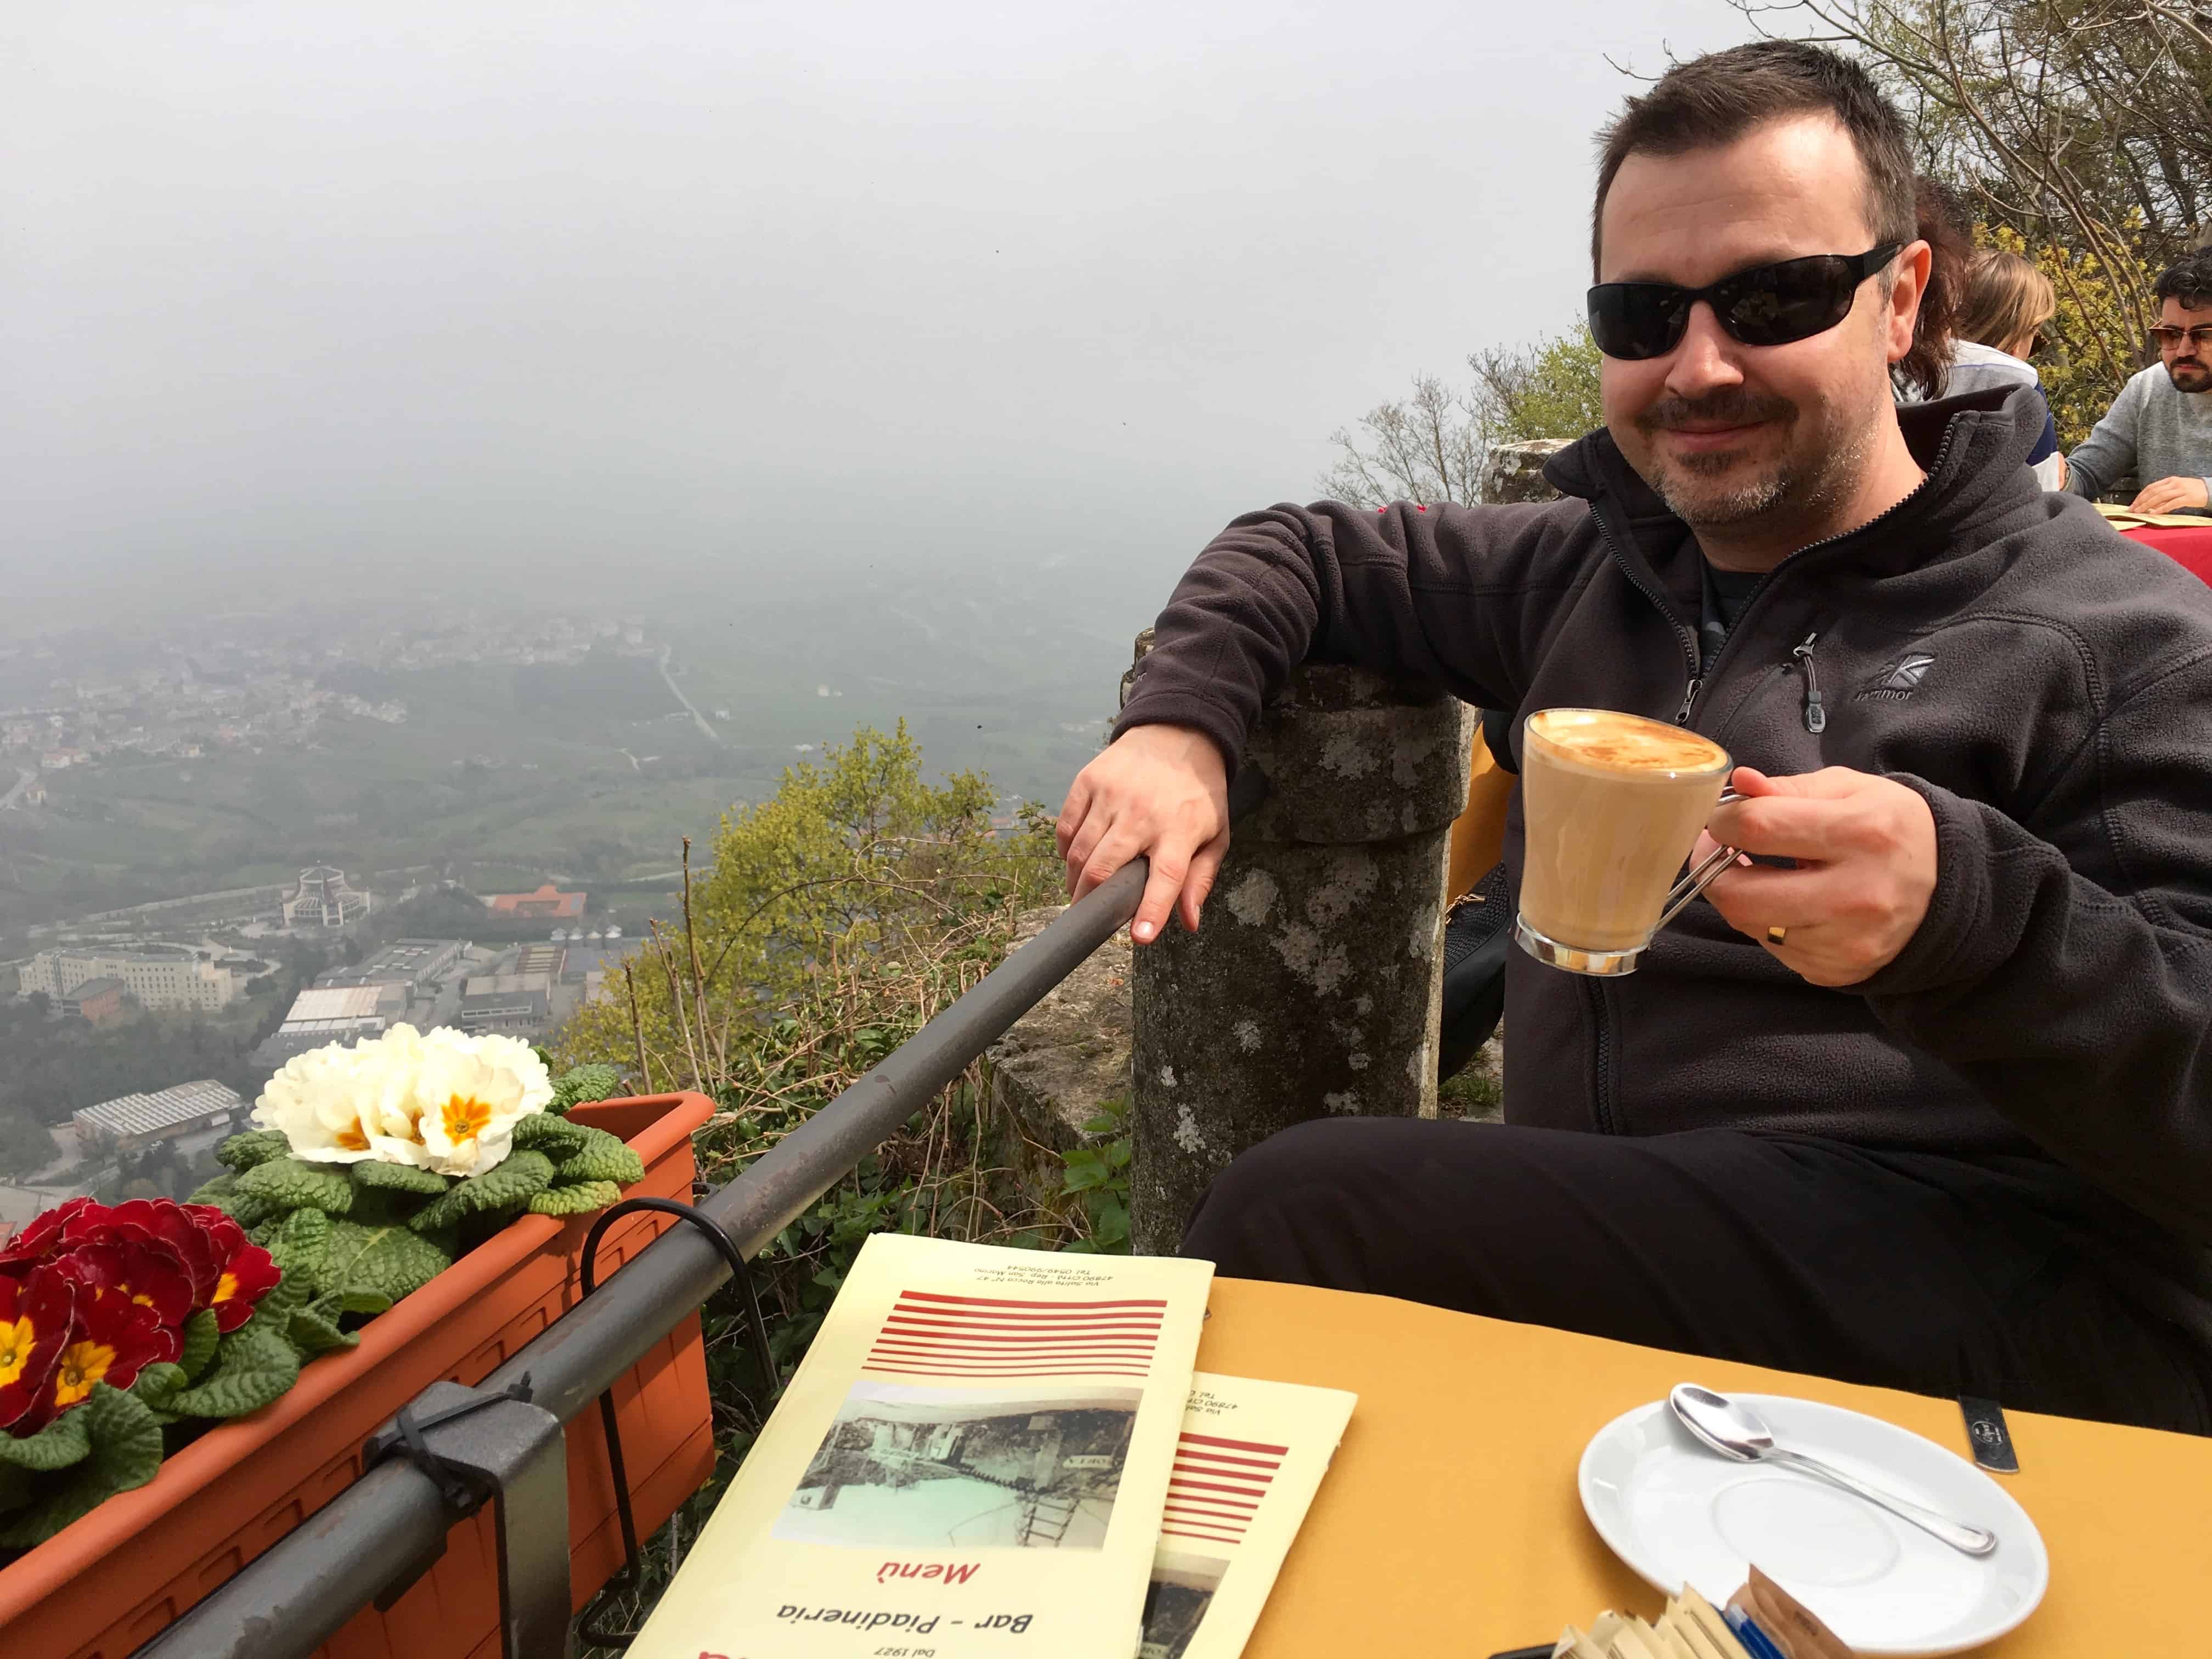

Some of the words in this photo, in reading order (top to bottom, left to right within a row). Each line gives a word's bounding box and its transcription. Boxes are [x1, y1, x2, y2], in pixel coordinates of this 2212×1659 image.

[1204, 1400, 1238, 1409] 47890
[877, 1562, 981, 1584] Menù
[776, 1605, 940, 1634] Piadineria
[974, 1615, 1033, 1634] Bar
[873, 1647, 909, 1657] 1927
[911, 1648, 935, 1658] Dal
